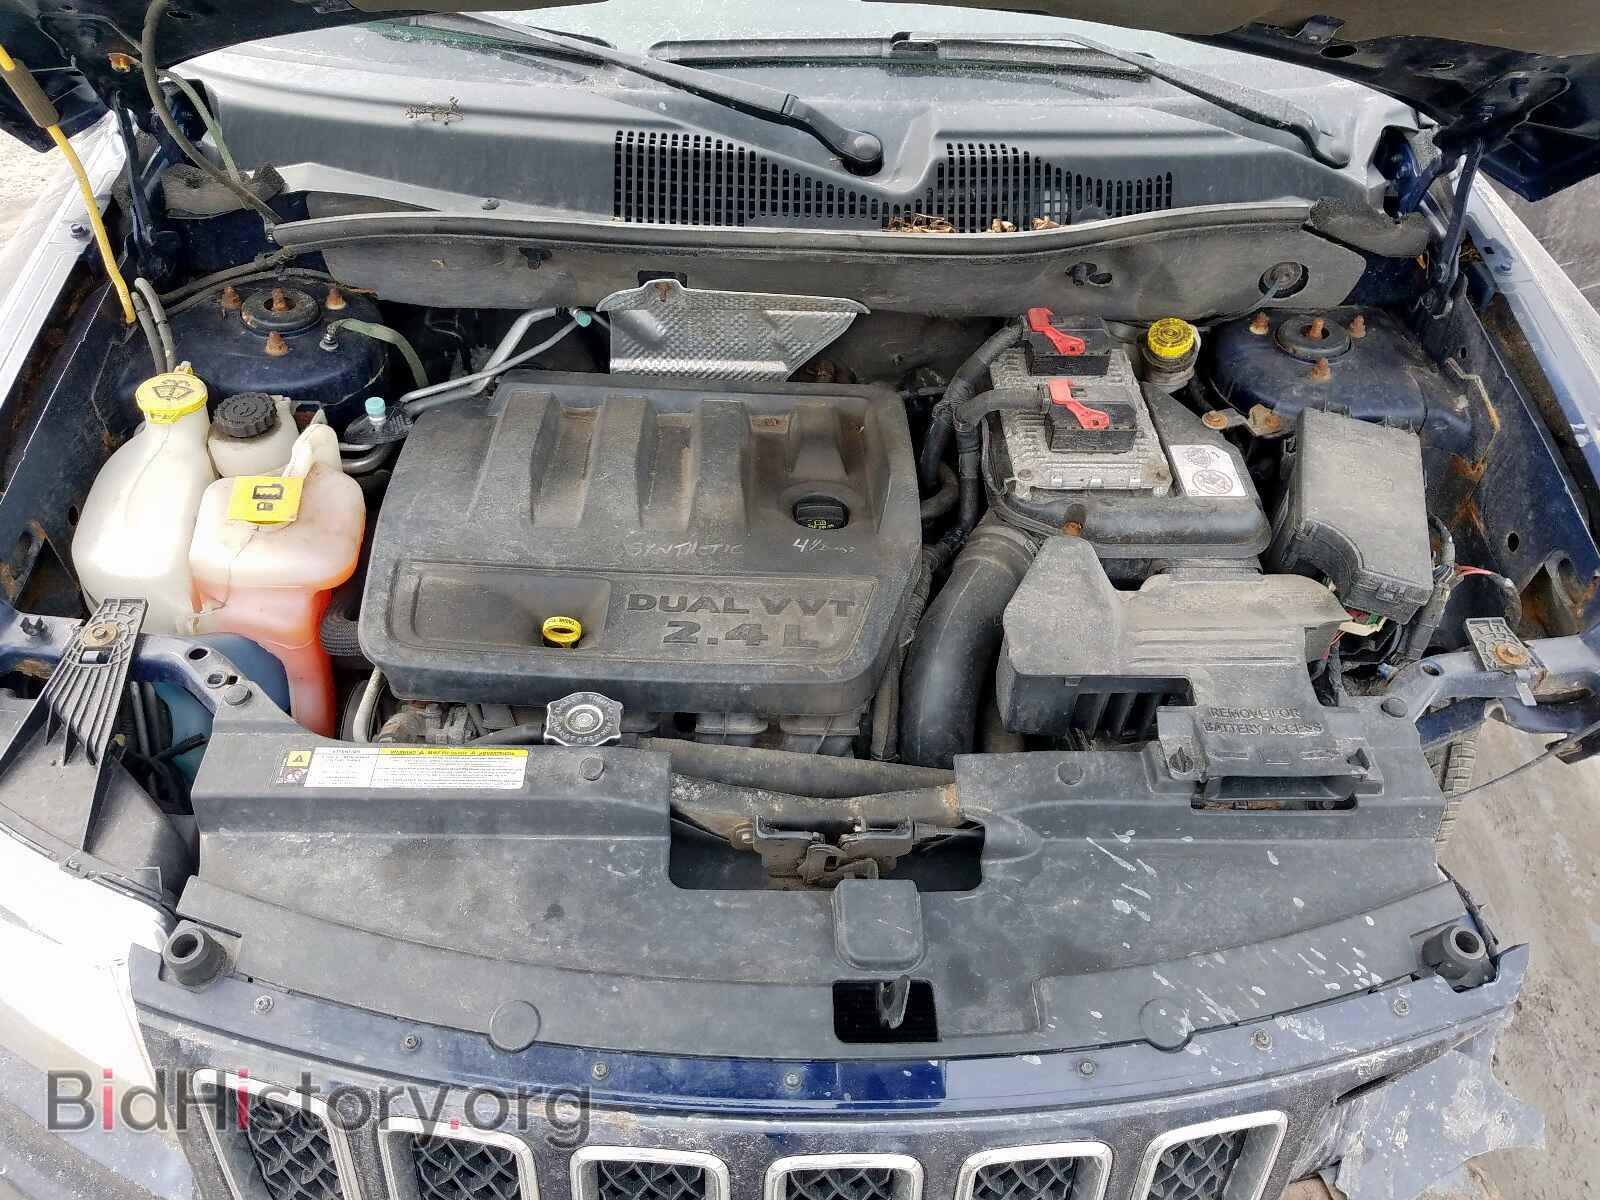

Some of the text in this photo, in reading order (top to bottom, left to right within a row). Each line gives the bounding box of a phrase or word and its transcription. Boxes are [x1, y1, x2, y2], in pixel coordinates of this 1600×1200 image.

[627, 593, 856, 618] DUAL VVT
[1209, 706, 1304, 720] REMOVE FOR
[1202, 721, 1325, 736] BATTERY ACCESS
